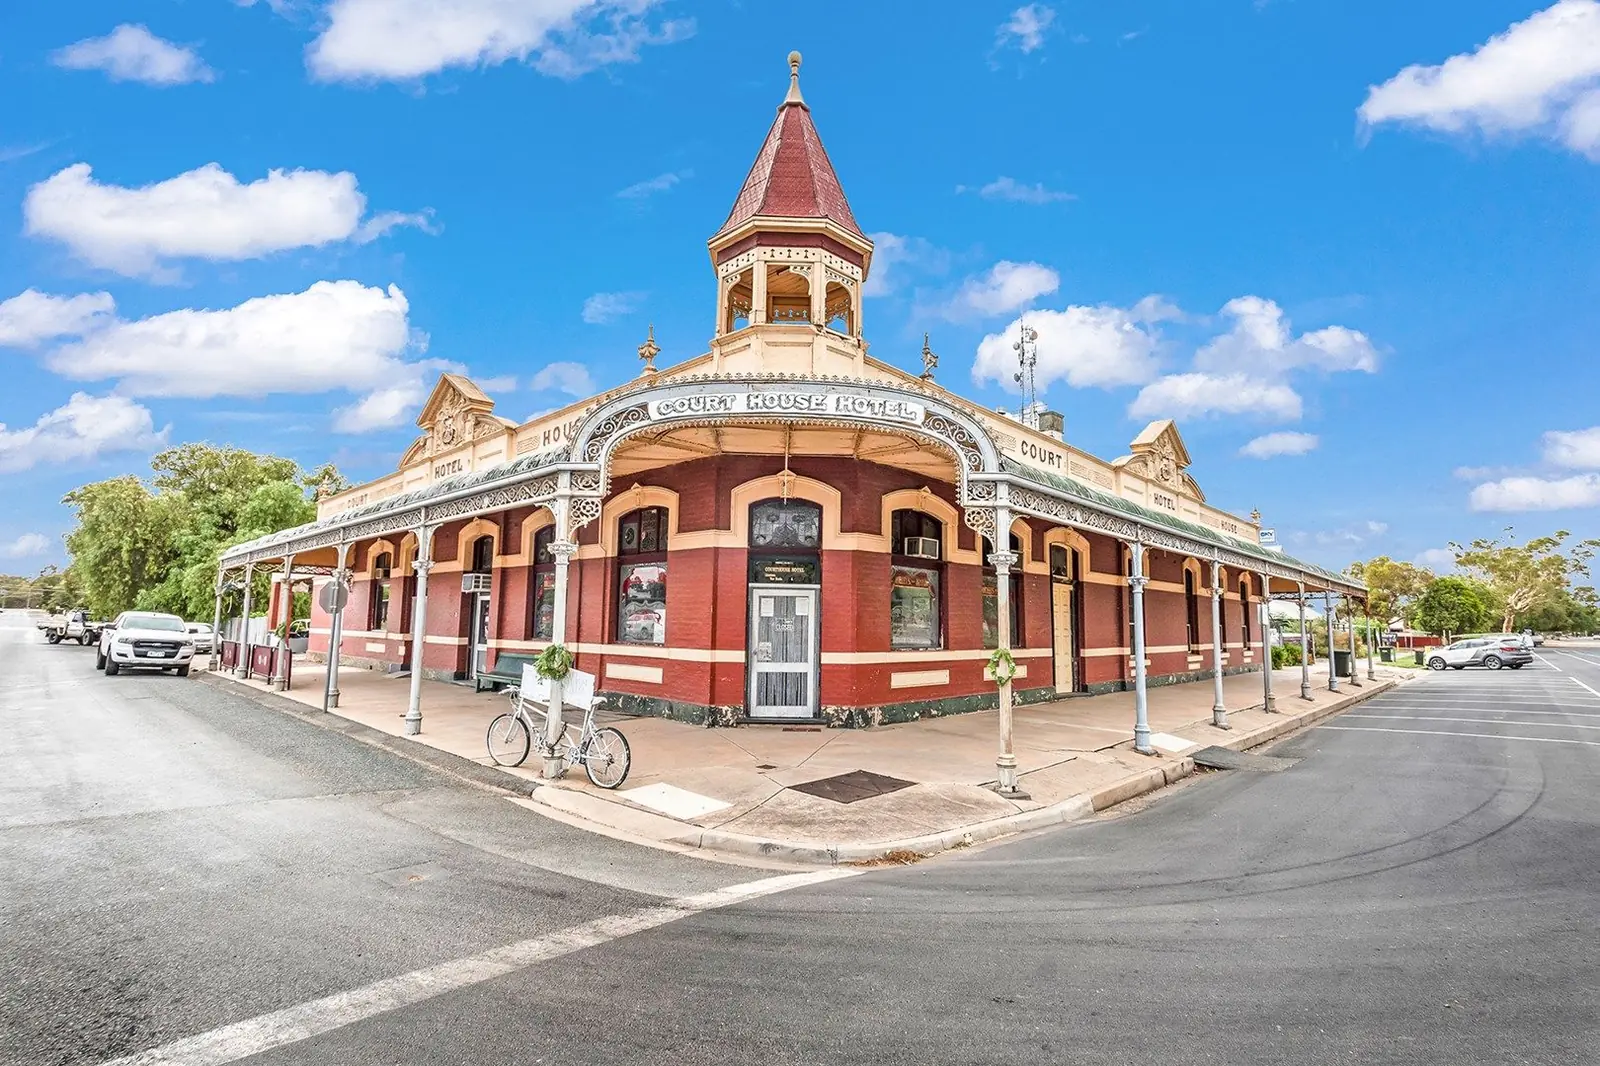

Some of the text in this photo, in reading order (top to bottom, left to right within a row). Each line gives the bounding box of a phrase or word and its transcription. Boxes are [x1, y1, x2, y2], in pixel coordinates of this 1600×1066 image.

[657, 393, 918, 422] COURT HOUSE HOTEL
[1021, 440, 1062, 468] COURT
[434, 458, 463, 479] HOTEL
[347, 493, 368, 509] COURT
[1153, 492, 1175, 511] HOTEL
[1221, 519, 1237, 534] HOUSE
